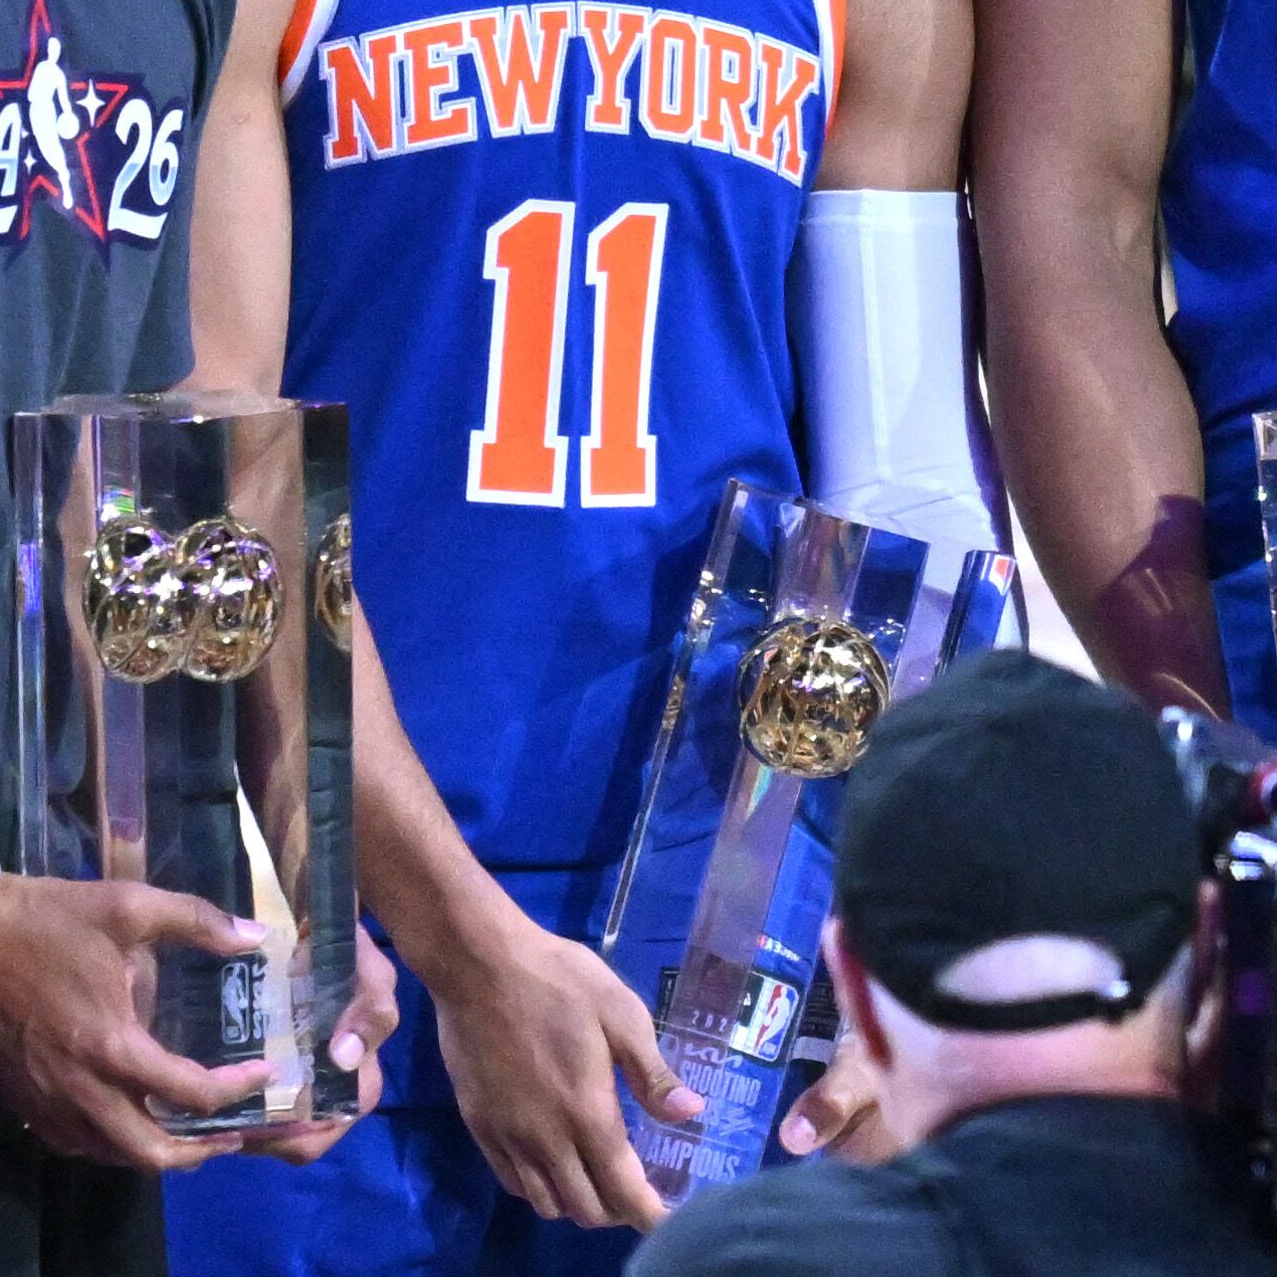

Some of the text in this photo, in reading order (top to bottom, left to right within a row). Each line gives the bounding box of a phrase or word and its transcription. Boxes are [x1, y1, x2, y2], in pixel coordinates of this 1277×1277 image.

[107, 96, 185, 240] 26
[321, 0, 821, 187] NEW YORK
[466, 198, 670, 509] 11
